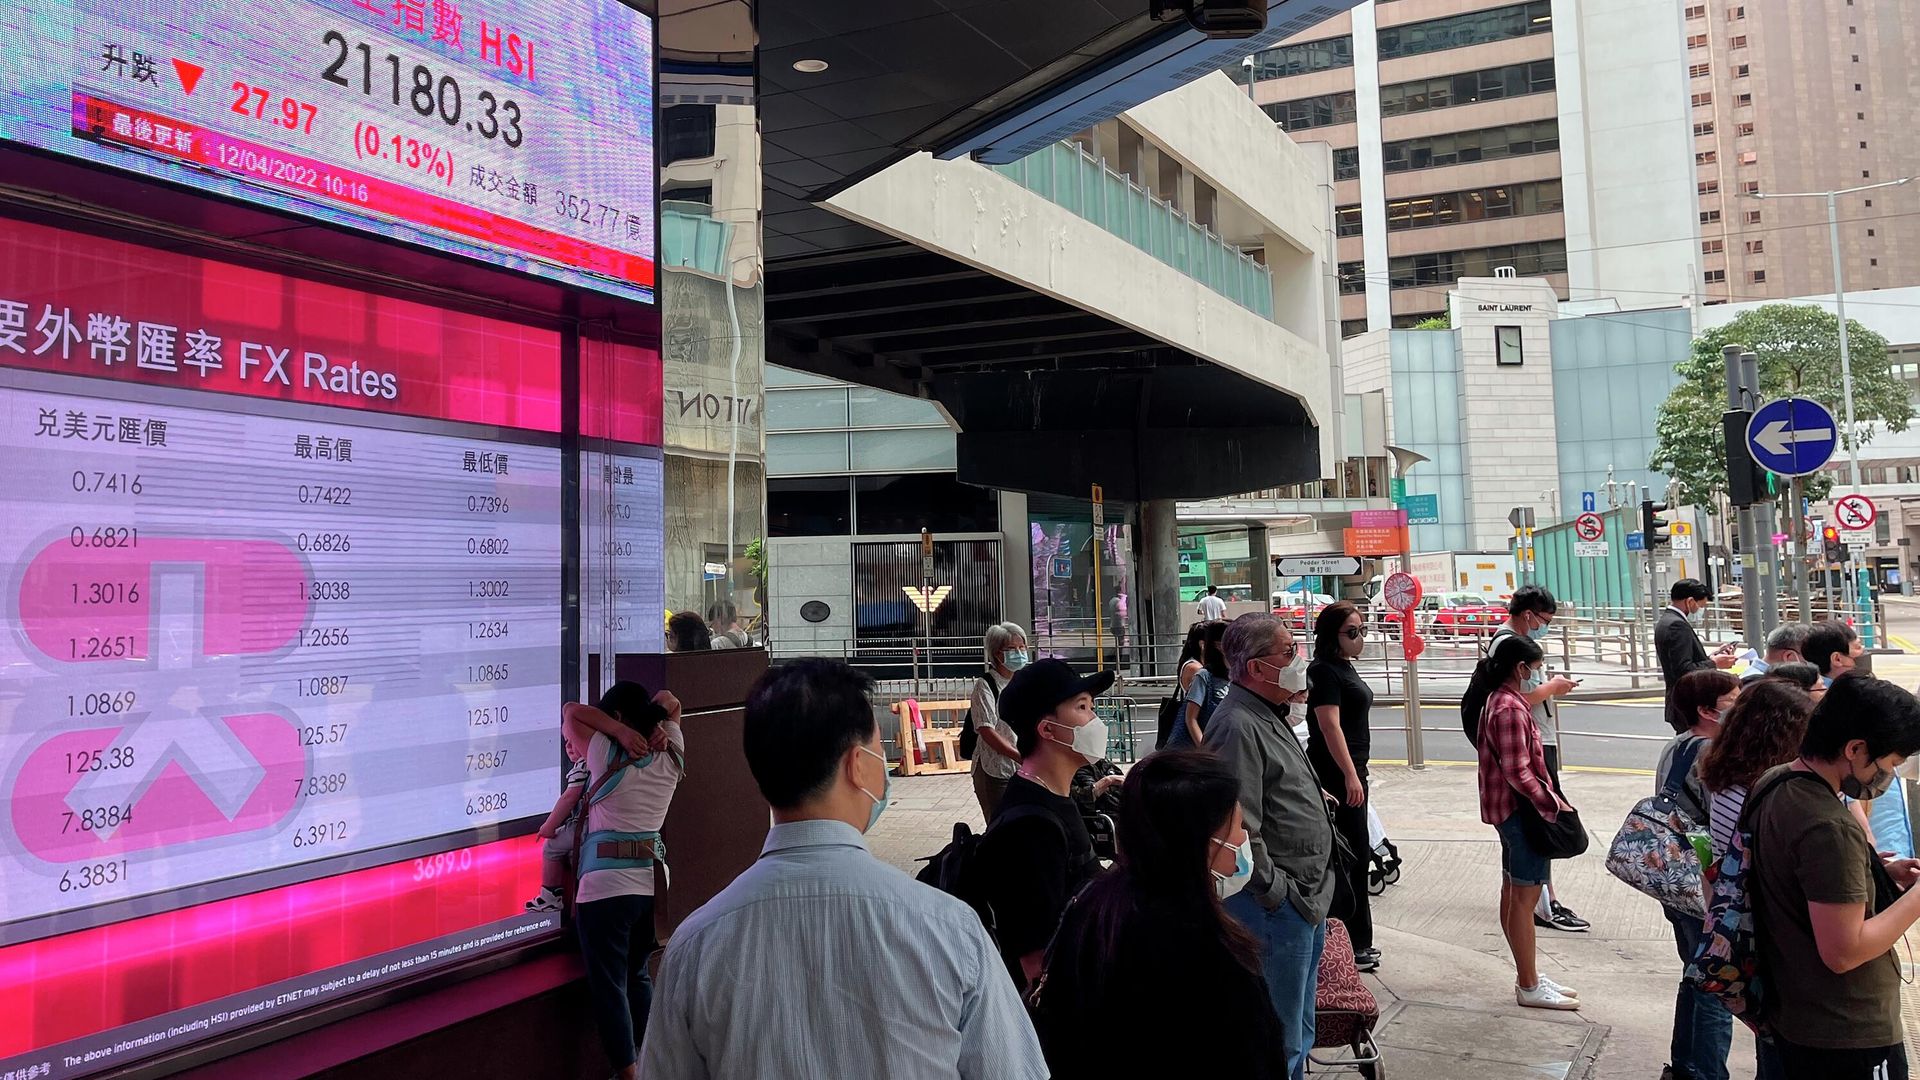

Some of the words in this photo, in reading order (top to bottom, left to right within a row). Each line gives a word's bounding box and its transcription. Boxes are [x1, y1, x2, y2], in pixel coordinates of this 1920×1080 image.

[480, 20, 535, 81] HSI
[102, 43, 158, 87] 升跌
[231, 81, 318, 135] 27.97
[354, 121, 454, 185] (0.13%)
[322, 30, 523, 148] 21180.33
[112, 113, 192, 153] 最後更新
[219, 143, 317, 188] 12/04/2022
[324, 175, 368, 203] 10:16
[469, 165, 538, 206] 成交金額
[555, 190, 620, 233] 352.77
[1478, 304, 1498, 312] SAINT
[1500, 304, 1532, 312] LAURENT
[240, 341, 290, 385] FX
[303, 352, 397, 399] Rates
[34, 408, 167, 447] 兌美元匯價
[294, 434, 353, 462] 最高價
[463, 451, 509, 475] 最低價
[72, 470, 142, 494] 0.7416
[298, 485, 351, 505] 0.7422
[467, 495, 509, 513] 0.7396
[71, 526, 138, 548] 0.6821
[297, 533, 350, 552] 0.6826
[467, 538, 509, 555] 0.6802
[72, 582, 139, 604] 1.3016
[299, 581, 350, 601] 1.3038
[468, 580, 509, 597] 1.3002
[70, 636, 135, 658] 1.2651
[298, 628, 349, 647] 1.2656
[468, 622, 509, 639] 1.2634
[68, 691, 136, 716] 1.0869
[297, 675, 348, 697] 1.0887
[468, 663, 508, 682] 1.0865
[65, 746, 134, 774] 125.38
[297, 723, 347, 746] 125.57
[468, 706, 508, 727] 125.10
[61, 803, 132, 834] 7.8384
[294, 772, 346, 798] 7.8389
[466, 750, 508, 772] 7.8367
[59, 859, 127, 892] 6.3831
[293, 820, 347, 848] 6.3912
[466, 792, 508, 815] 6.3828
[413, 848, 472, 882] 3699.0
[63, 1056, 82, 1068] The
[84, 1046, 112, 1062] above
[114, 1030, 166, 1054] information
[167, 1019, 209, 1039] (including
[210, 1012, 229, 1025] HSI)
[230, 1001, 264, 1021] provided
[265, 999, 275, 1010] by
[277, 989, 303, 1005] ETNET
[304, 985, 319, 998] may
[321, 977, 347, 996] subject
[347, 975, 355, 985] to
[356, 974, 361, 982] a
[362, 967, 380, 981] delay
[381, 963, 389, 974] of
[390, 960, 400, 972] not
[401, 957, 414, 968] less
[415, 953, 429, 965] than
[430, 950, 437, 960] 15
[438, 944, 462, 958] minutes
[463, 941, 473, 951] and
[474, 939, 480, 948] is
[480, 932, 504, 946] provided
[505, 929, 513, 939] for
[514, 923, 538, 936] reference
